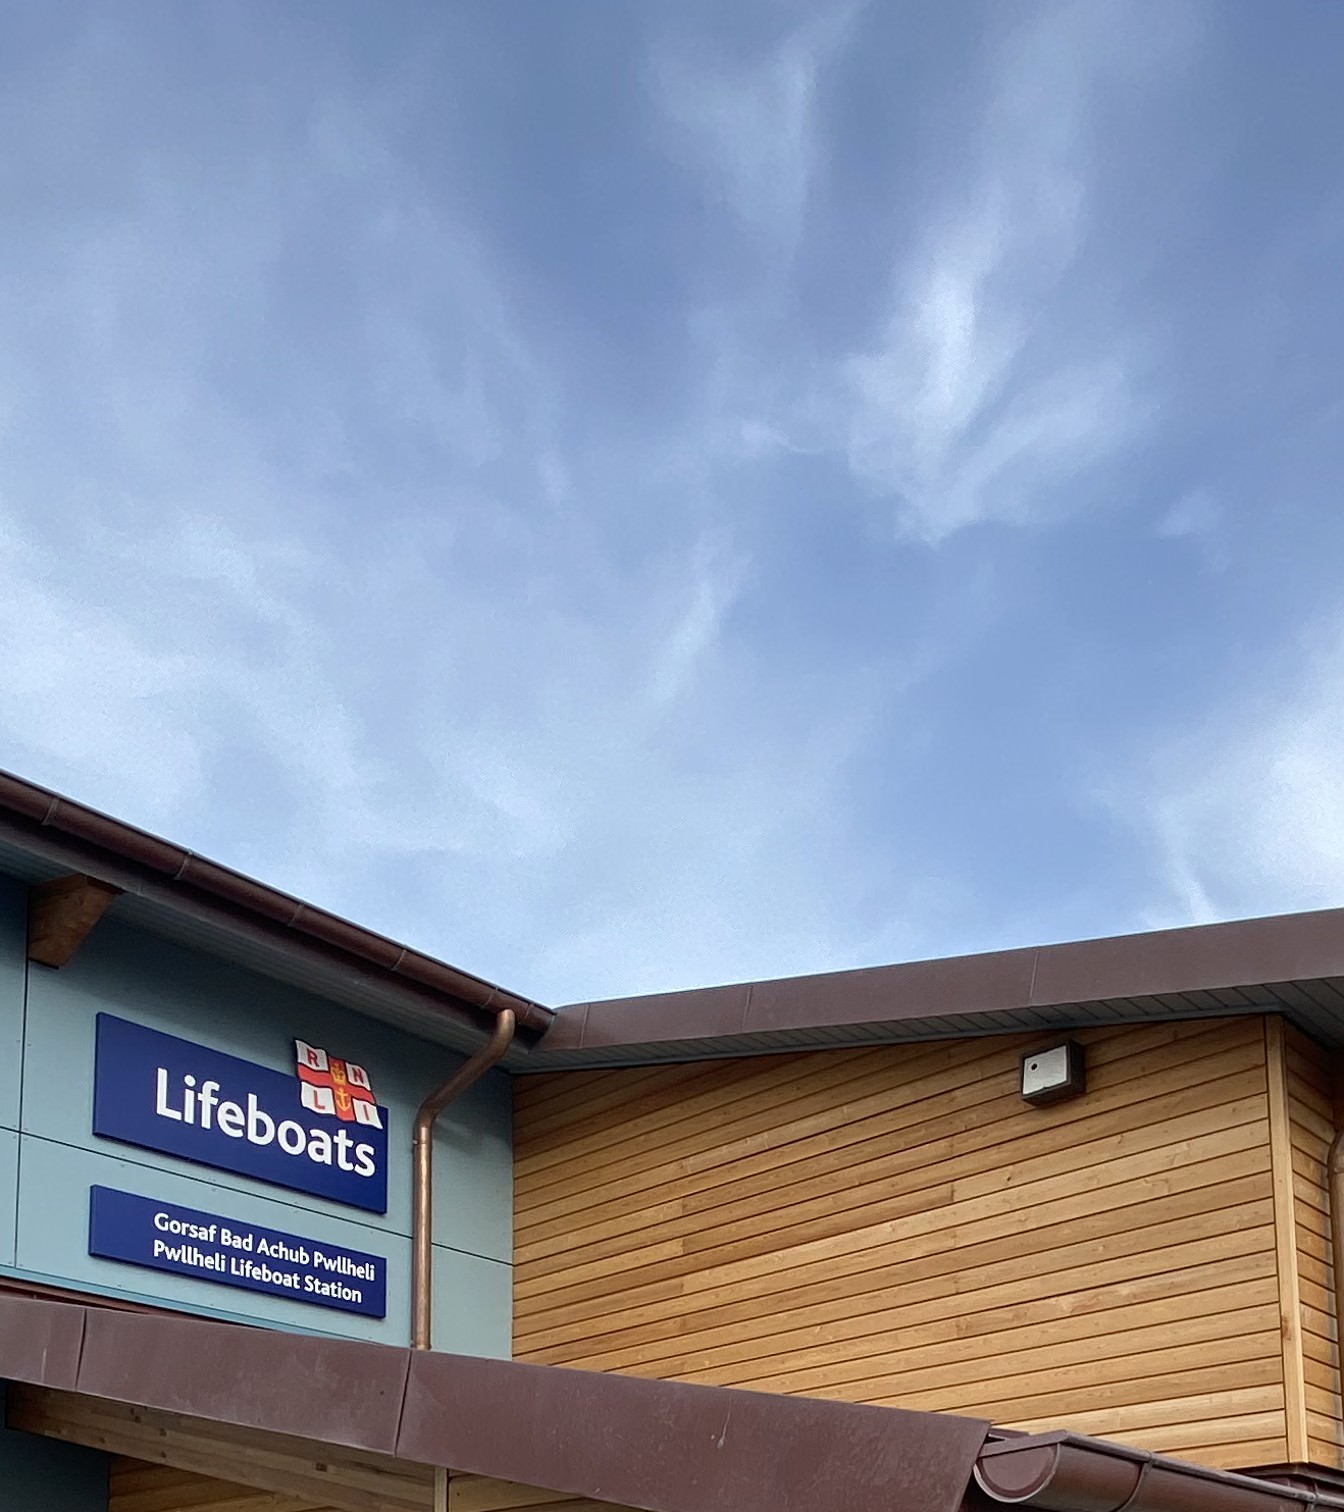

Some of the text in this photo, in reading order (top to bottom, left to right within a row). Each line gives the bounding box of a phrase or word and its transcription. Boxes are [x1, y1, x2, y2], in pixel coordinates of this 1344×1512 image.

[155, 1066, 376, 1178] Lifeboats
[153, 1212, 376, 1282] Gorsaf Bad Achub Pwllheli
[153, 1239, 362, 1304] Pwllheli Lifeboat Station
